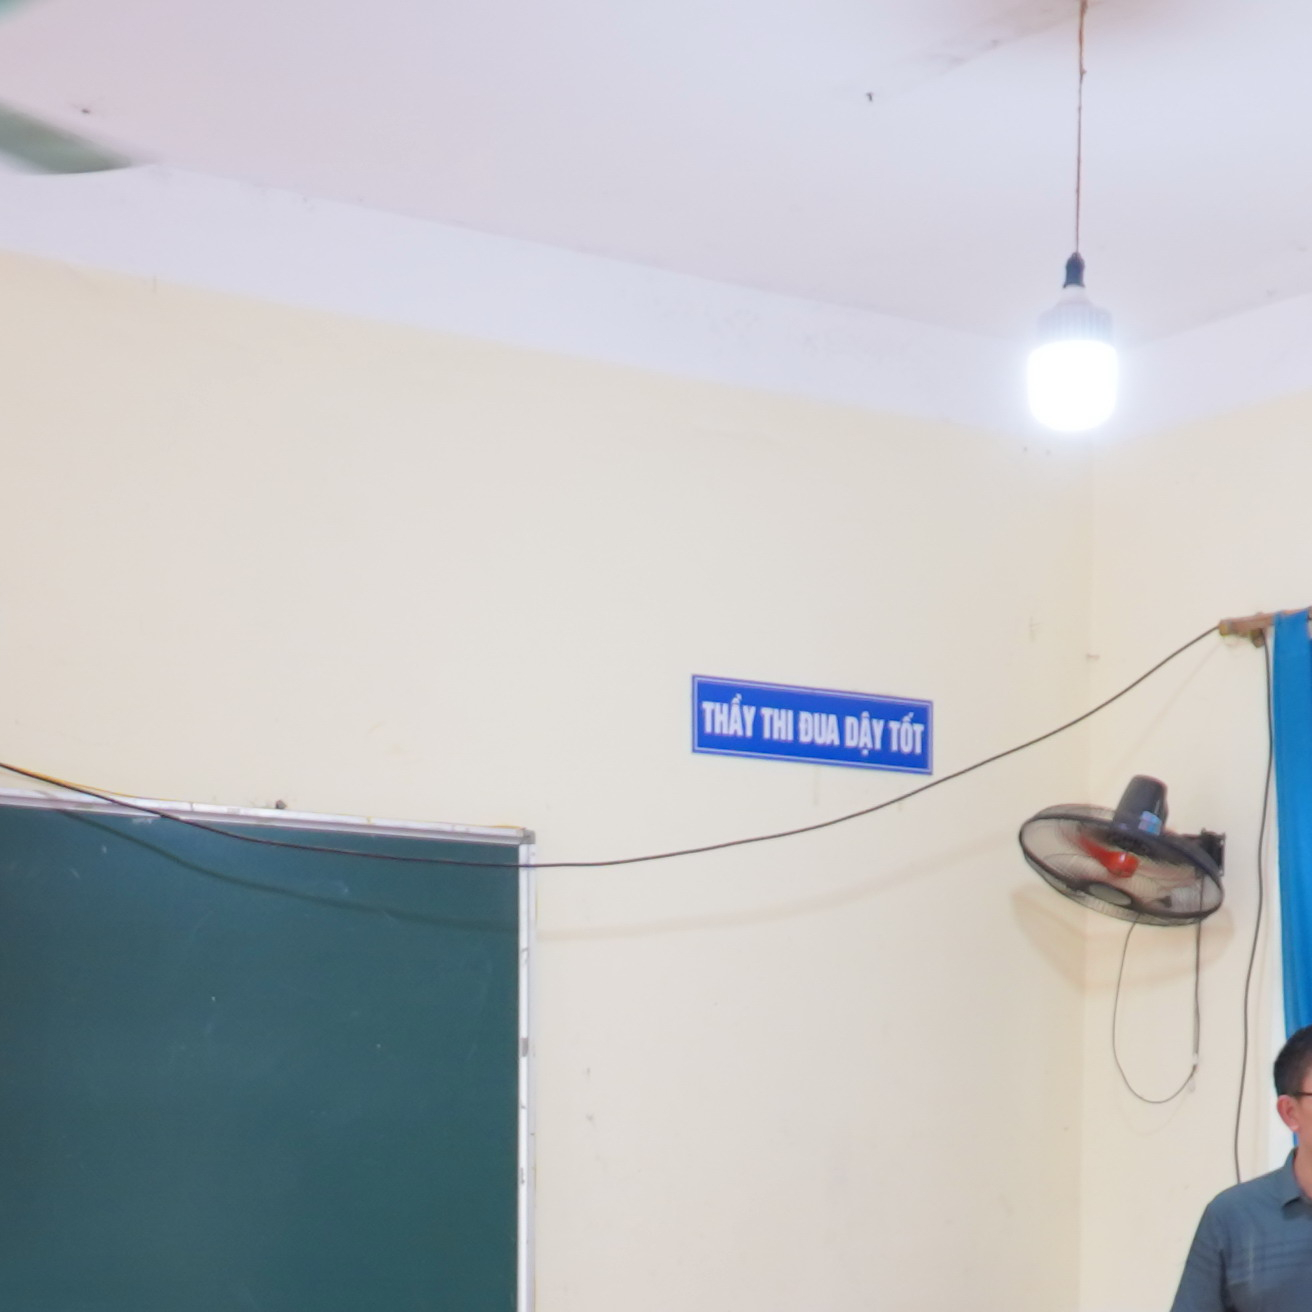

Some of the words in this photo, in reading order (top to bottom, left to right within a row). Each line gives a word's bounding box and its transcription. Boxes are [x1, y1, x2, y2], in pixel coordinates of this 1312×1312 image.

[761, 707, 794, 741] THI
[798, 711, 840, 746] ĐUA
[845, 711, 885, 756] DẬY
[889, 712, 925, 755] TỐT
